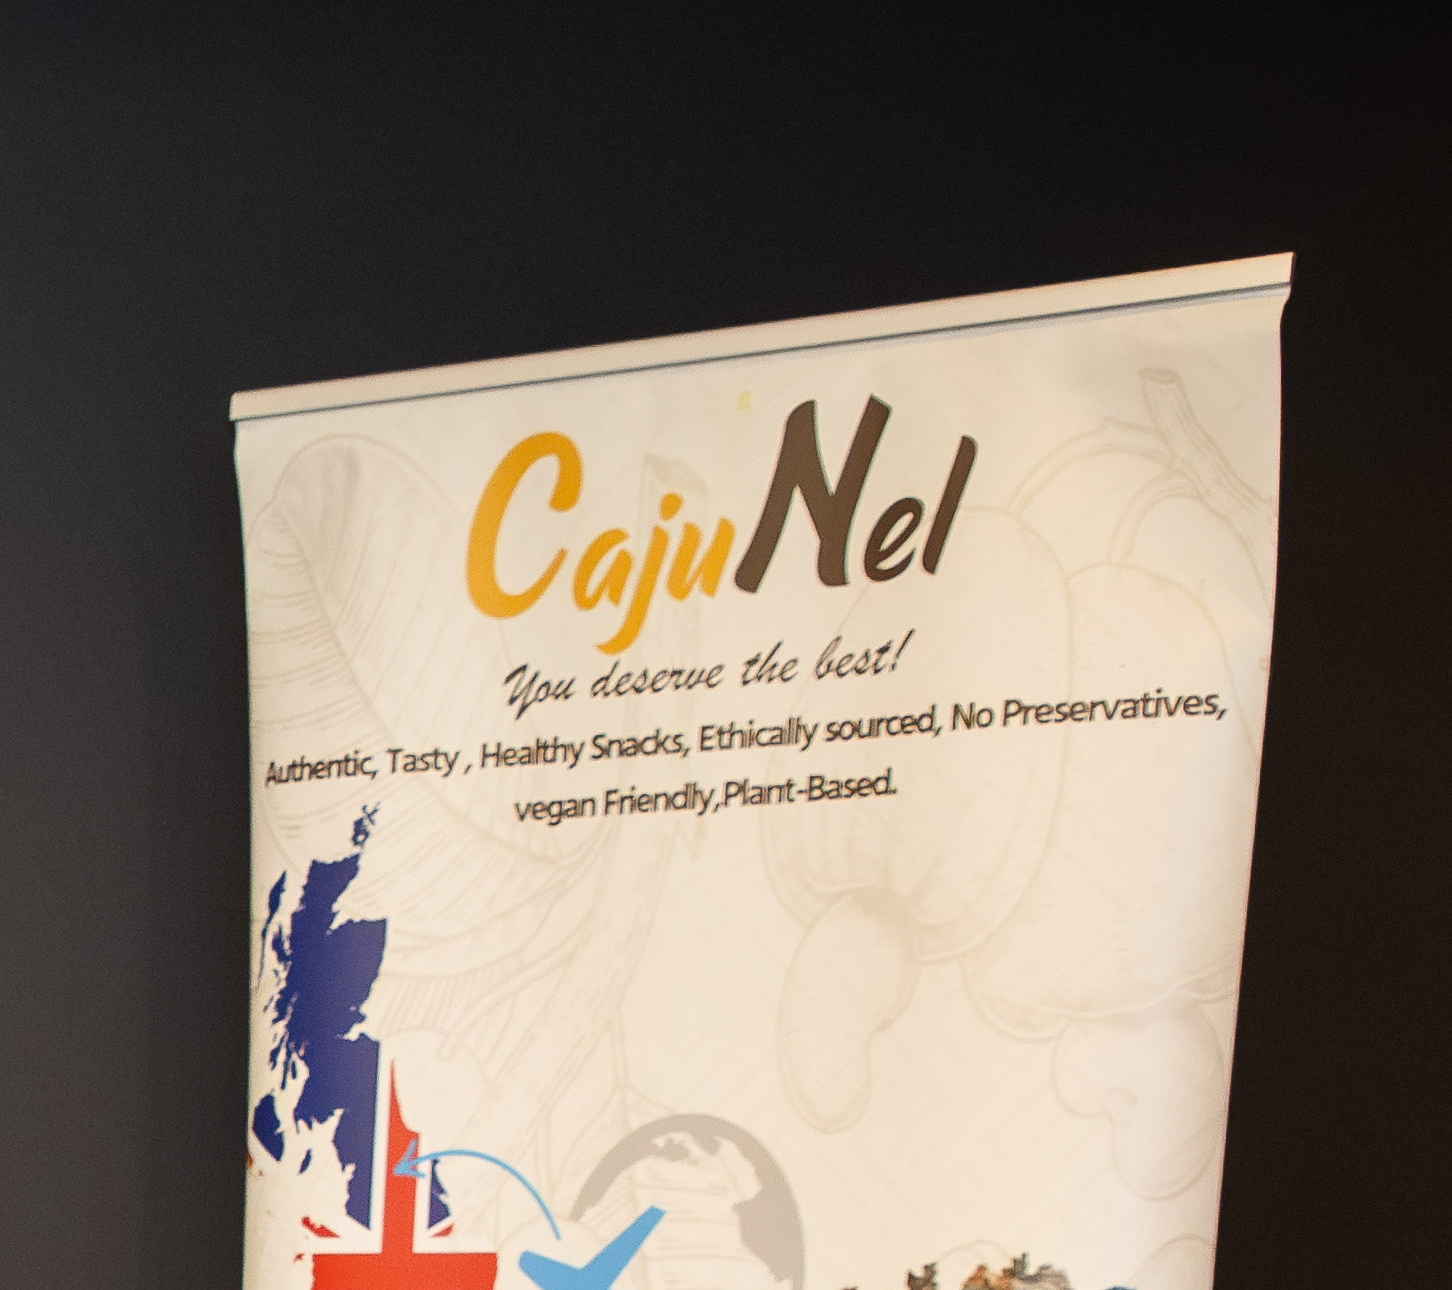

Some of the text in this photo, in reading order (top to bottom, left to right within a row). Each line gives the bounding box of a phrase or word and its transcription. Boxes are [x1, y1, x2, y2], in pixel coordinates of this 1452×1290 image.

[465, 395, 978, 655] CajuNel
[504, 628, 915, 720] You deserve the best!
[265, 750, 378, 787] Authentic,
[481, 736, 585, 769] Healthy
[590, 728, 691, 760] Snacks,
[700, 716, 819, 752] Ethically
[825, 704, 942, 742] sourced,
[952, 702, 994, 730] No
[1003, 688, 1227, 727] Preservatives,
[515, 797, 596, 826] vegan
